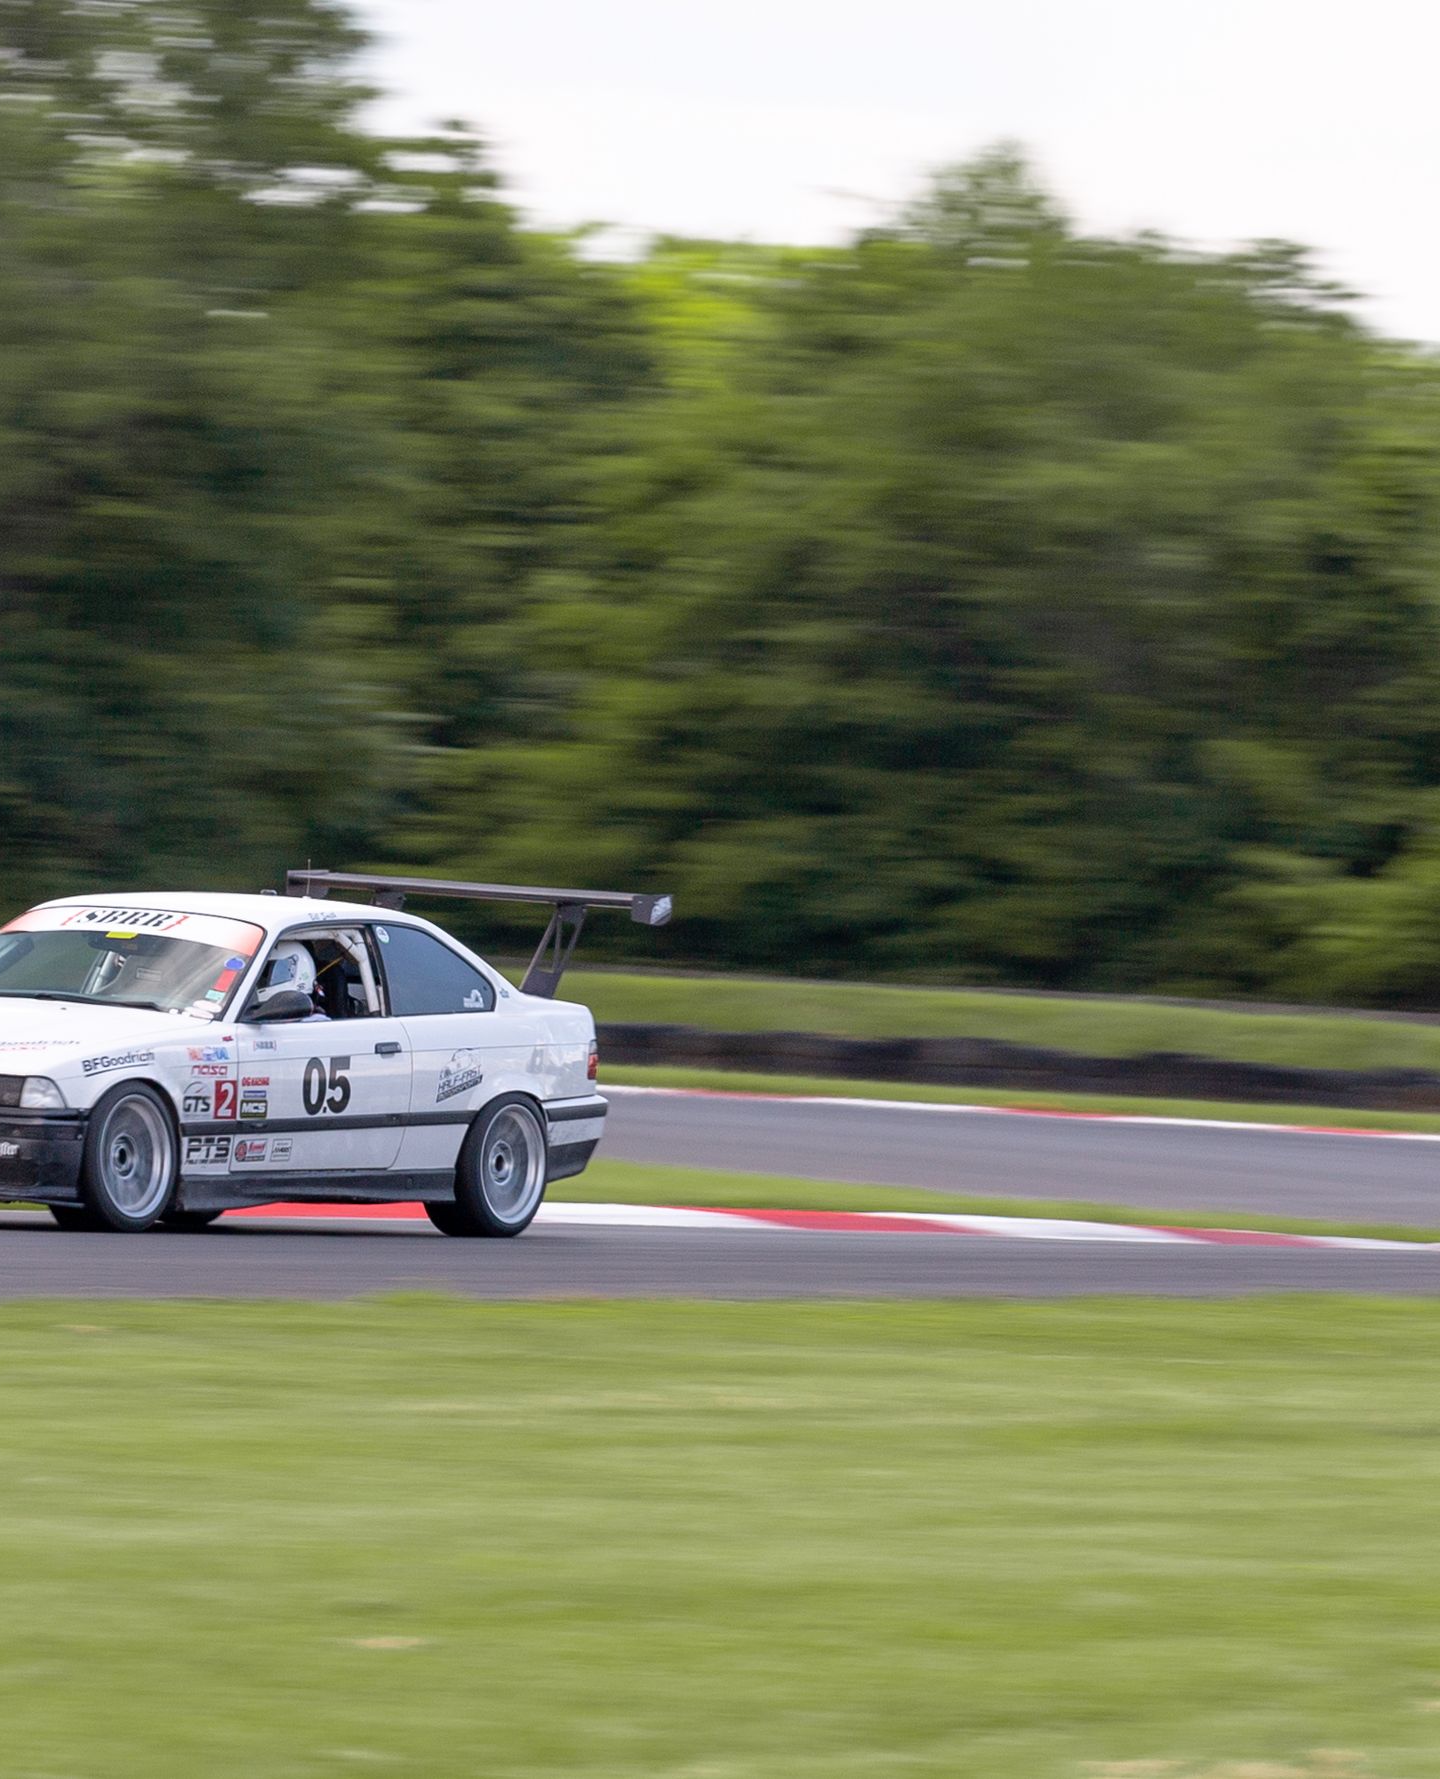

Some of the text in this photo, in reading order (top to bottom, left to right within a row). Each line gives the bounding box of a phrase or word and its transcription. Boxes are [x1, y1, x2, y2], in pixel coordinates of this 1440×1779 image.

[81, 1050, 156, 1073] BFGoodrich
[183, 1082, 235, 1117] GTS 2
[241, 1102, 266, 1113] MCS
